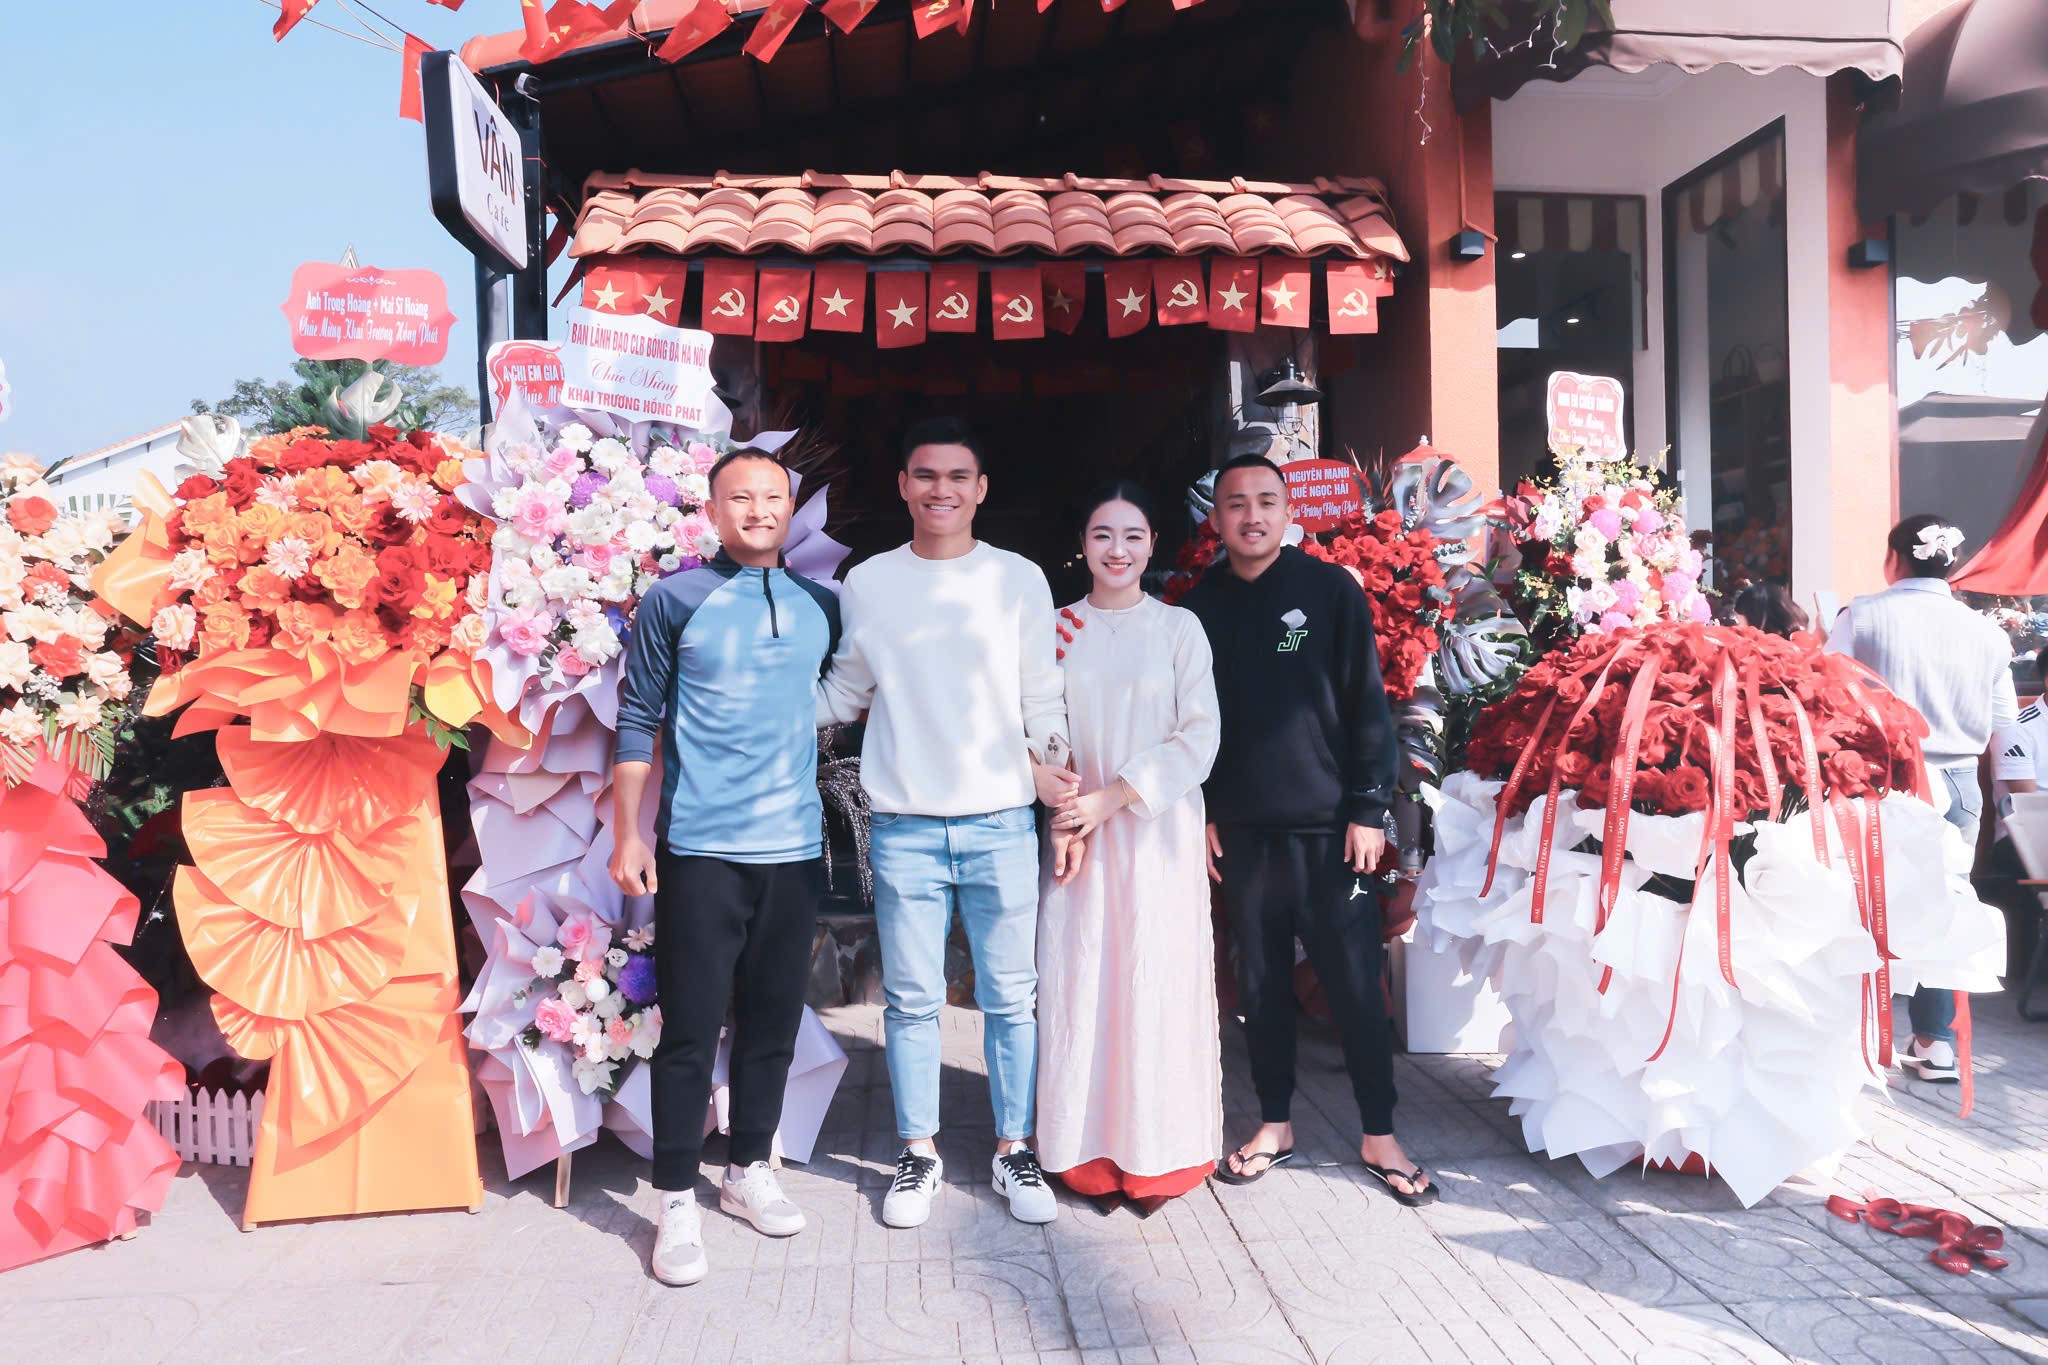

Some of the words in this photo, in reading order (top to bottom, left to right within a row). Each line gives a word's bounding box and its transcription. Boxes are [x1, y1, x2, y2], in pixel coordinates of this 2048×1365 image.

[474, 110, 516, 206] VÂN
[486, 193, 510, 232] Cafe
[572, 322, 589, 346] BAN
[590, 323, 612, 351] LÃNH
[613, 330, 629, 357] ĐẠO
[631, 334, 645, 356] CLB
[647, 333, 668, 361] BÓNG
[528, 364, 543, 382] EM
[544, 364, 560, 382] GIA
[592, 358, 626, 383] Chúc
[630, 367, 679, 400] Mừng
[568, 387, 594, 404] KHAI
[598, 391, 641, 412] TRƯƠNG
[1324, 466, 1350, 482] MẠNH
[1291, 482, 1307, 500] QUẾ
[1309, 484, 1332, 499] NGỌC
[1334, 479, 1349, 496] HẢI
[1617, 817, 1625, 835] LOVE
[1537, 838, 1550, 868] ETERNAL
[1537, 868, 1544, 876] IS
[1873, 875, 1881, 892] LOVE
[1535, 877, 1544, 894] LOVE
[1874, 903, 1884, 935] ETERNAL
